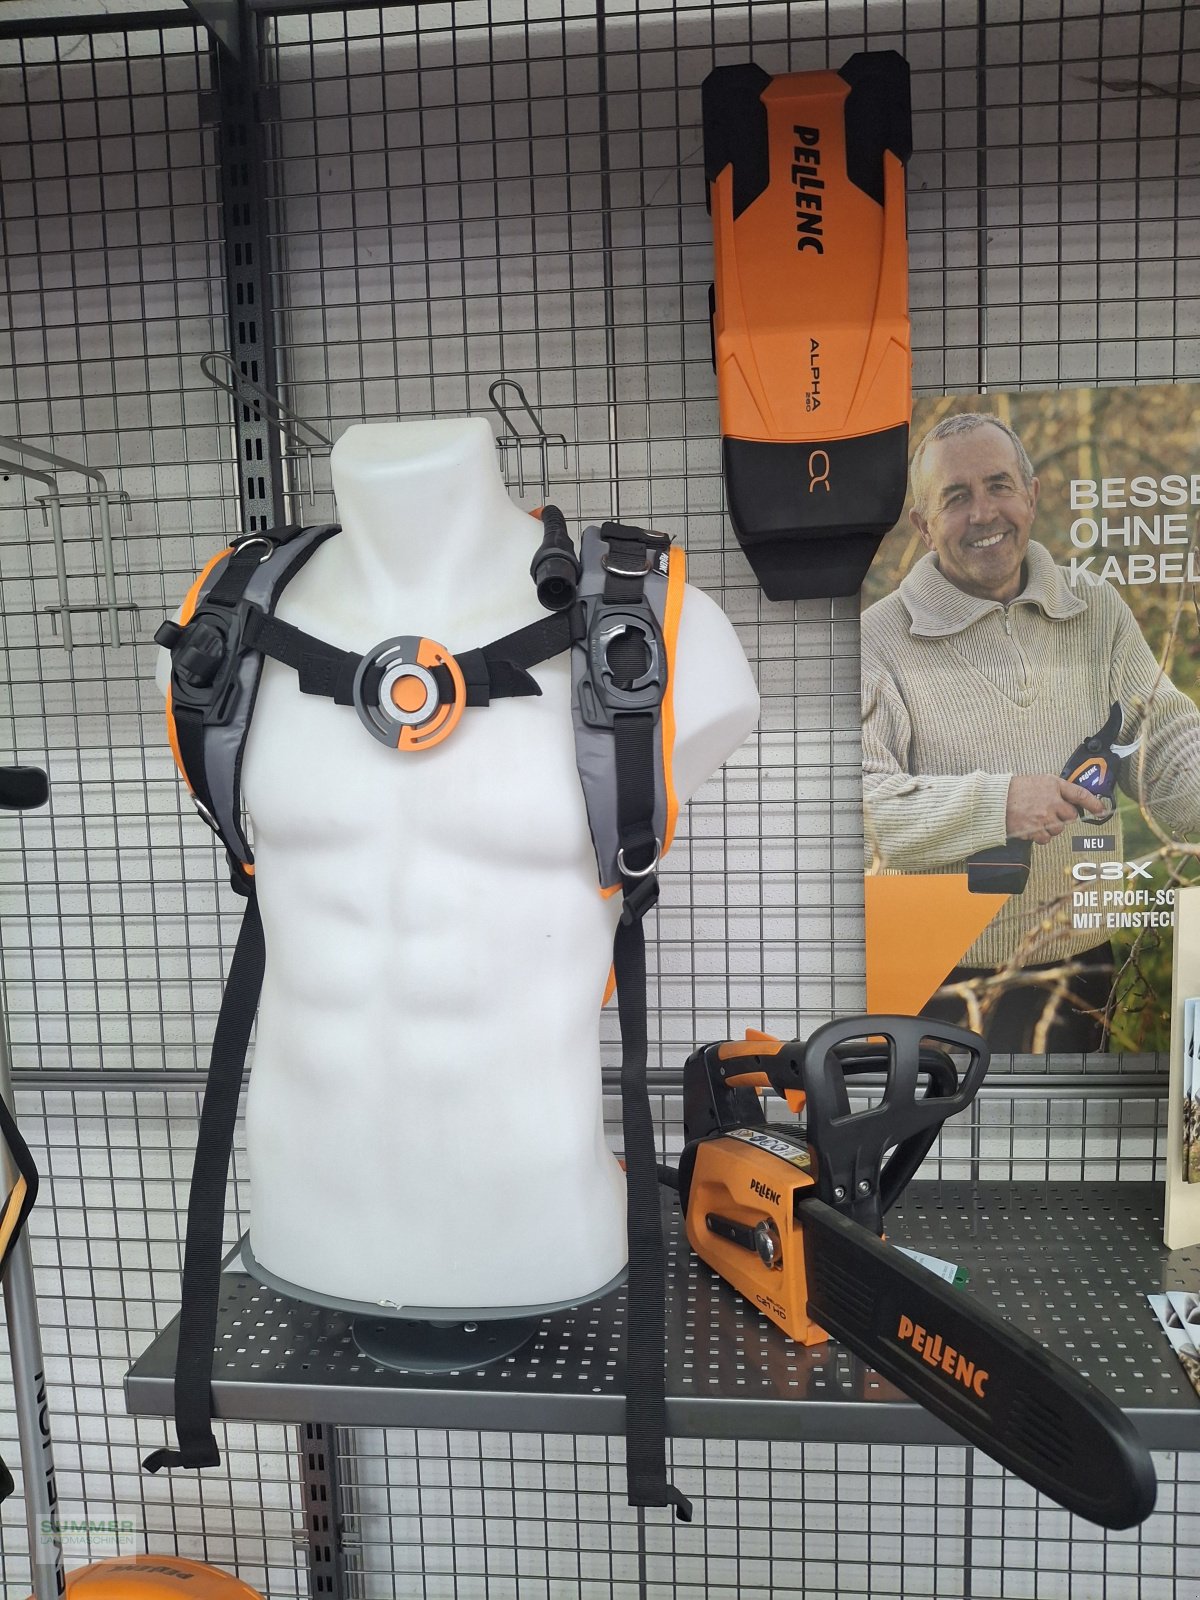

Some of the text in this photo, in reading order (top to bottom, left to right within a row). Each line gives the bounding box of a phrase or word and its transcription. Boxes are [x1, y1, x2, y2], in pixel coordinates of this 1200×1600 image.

[791, 125, 824, 254] PELLENC
[810, 338, 821, 411] ALPHA
[1070, 514, 1189, 549] OHNE
[1070, 552, 1200, 588] KABEL
[1083, 838, 1104, 849] NEU
[1072, 861, 1154, 881] C3X
[1073, 889, 1175, 907] DIE PROFI-SC
[1073, 913, 1103, 929] MIT
[750, 1178, 781, 1206] PELLENC
[772, 1305, 787, 1320] HD
[897, 1314, 989, 1398] PELLENC
